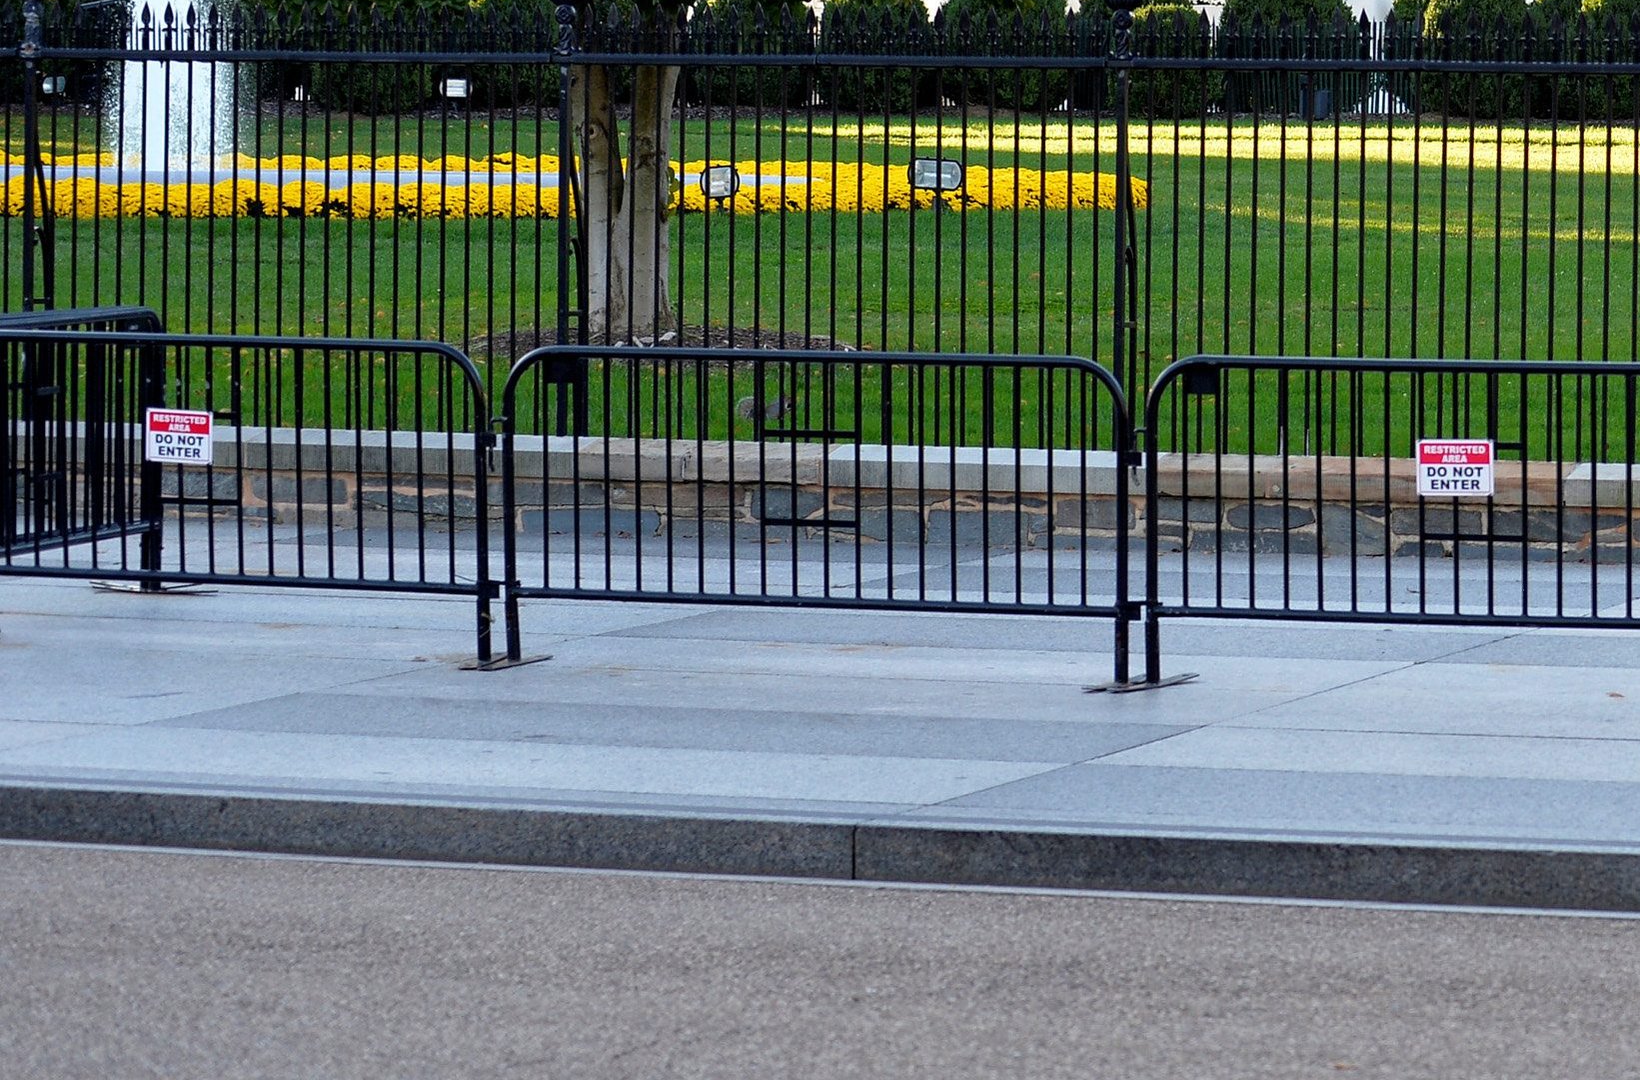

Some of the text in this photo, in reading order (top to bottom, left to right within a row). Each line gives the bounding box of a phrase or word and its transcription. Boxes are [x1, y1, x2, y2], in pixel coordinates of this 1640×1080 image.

[153, 414, 207, 425] RESTRICTED
[168, 423, 191, 432] AREA
[155, 434, 204, 446] DO NOT
[158, 446, 201, 458] ENTER
[1423, 445, 1486, 455] RESTRICTED
[1441, 454, 1468, 463] AREA
[1427, 466, 1483, 477] DO NOT
[1431, 479, 1480, 490] ENTER
